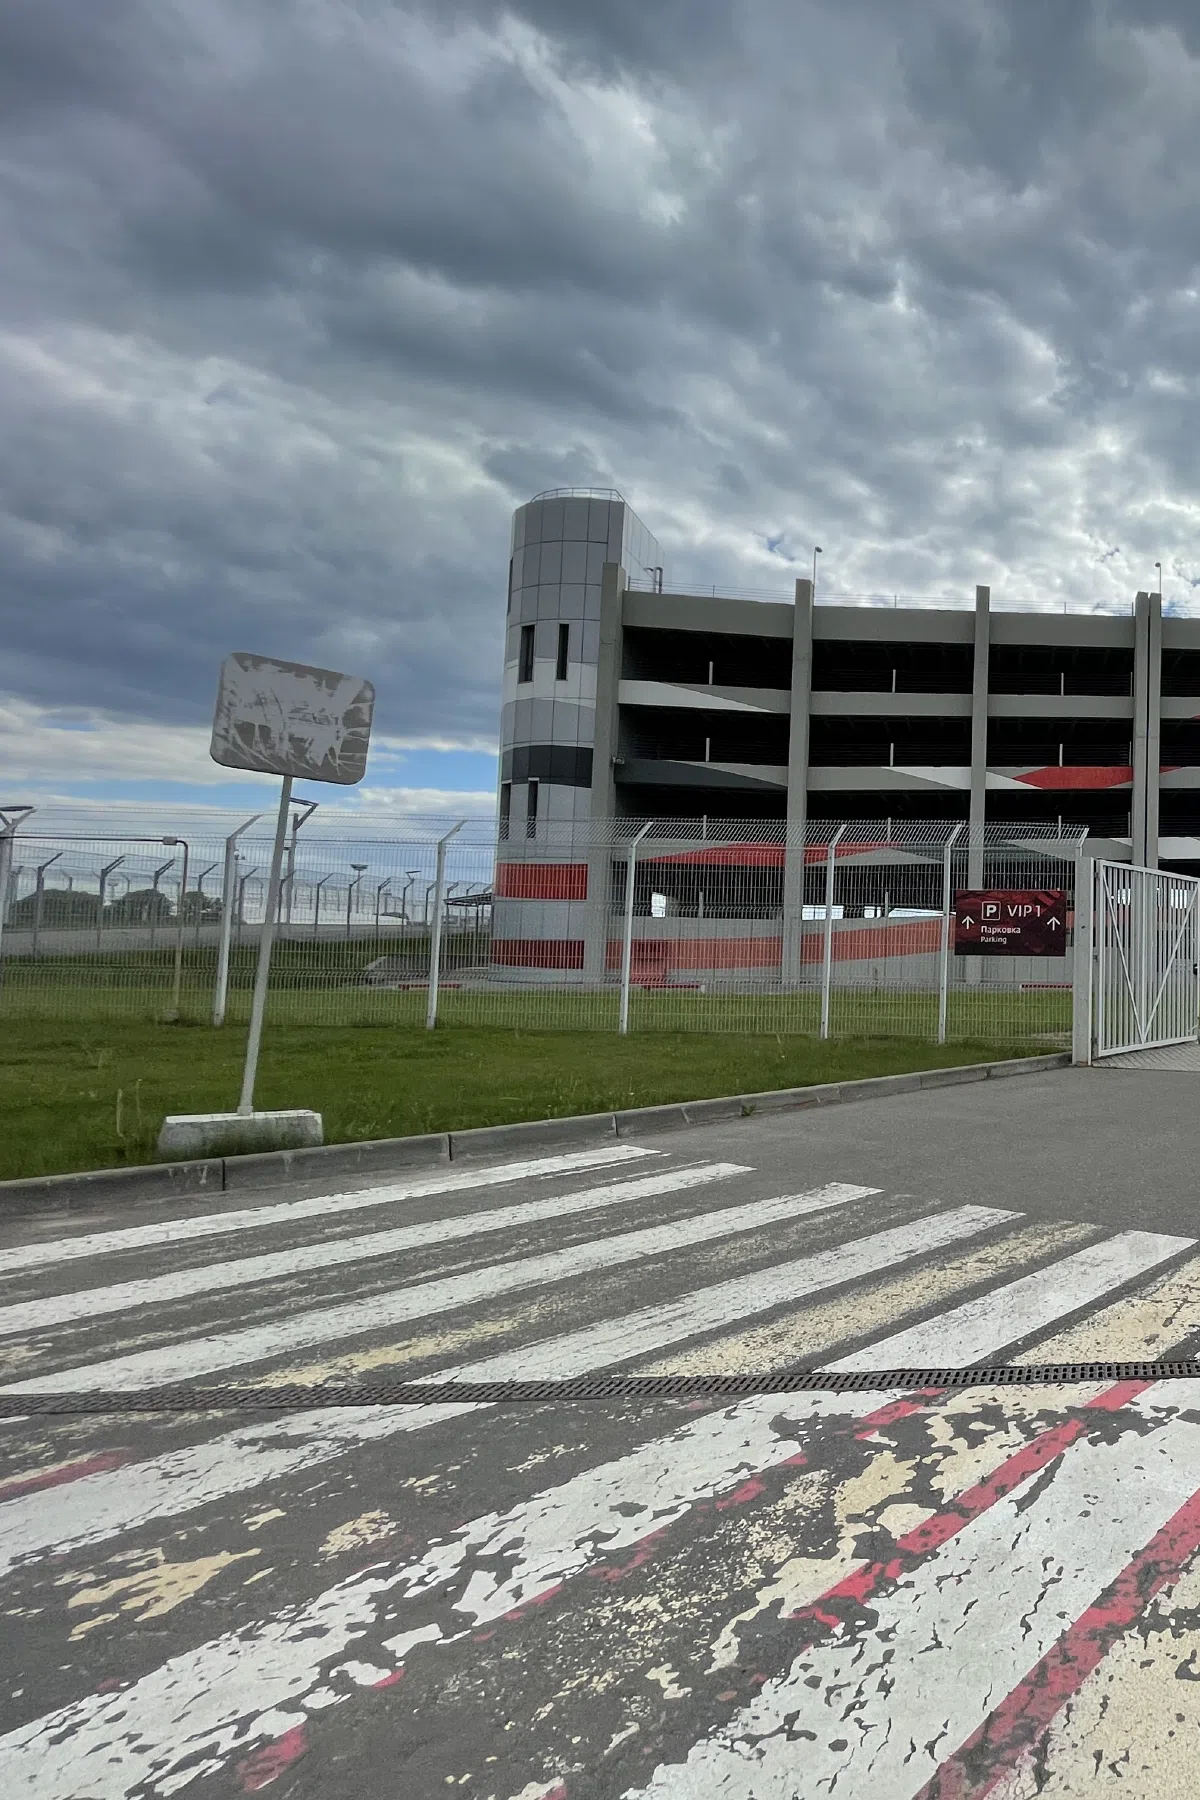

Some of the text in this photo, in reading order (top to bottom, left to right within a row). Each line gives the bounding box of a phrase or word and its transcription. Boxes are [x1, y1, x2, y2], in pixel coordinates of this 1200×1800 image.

[986, 904, 997, 917] P
[981, 925, 1021, 935] Парковка
[980, 936, 1007, 945] Parking
